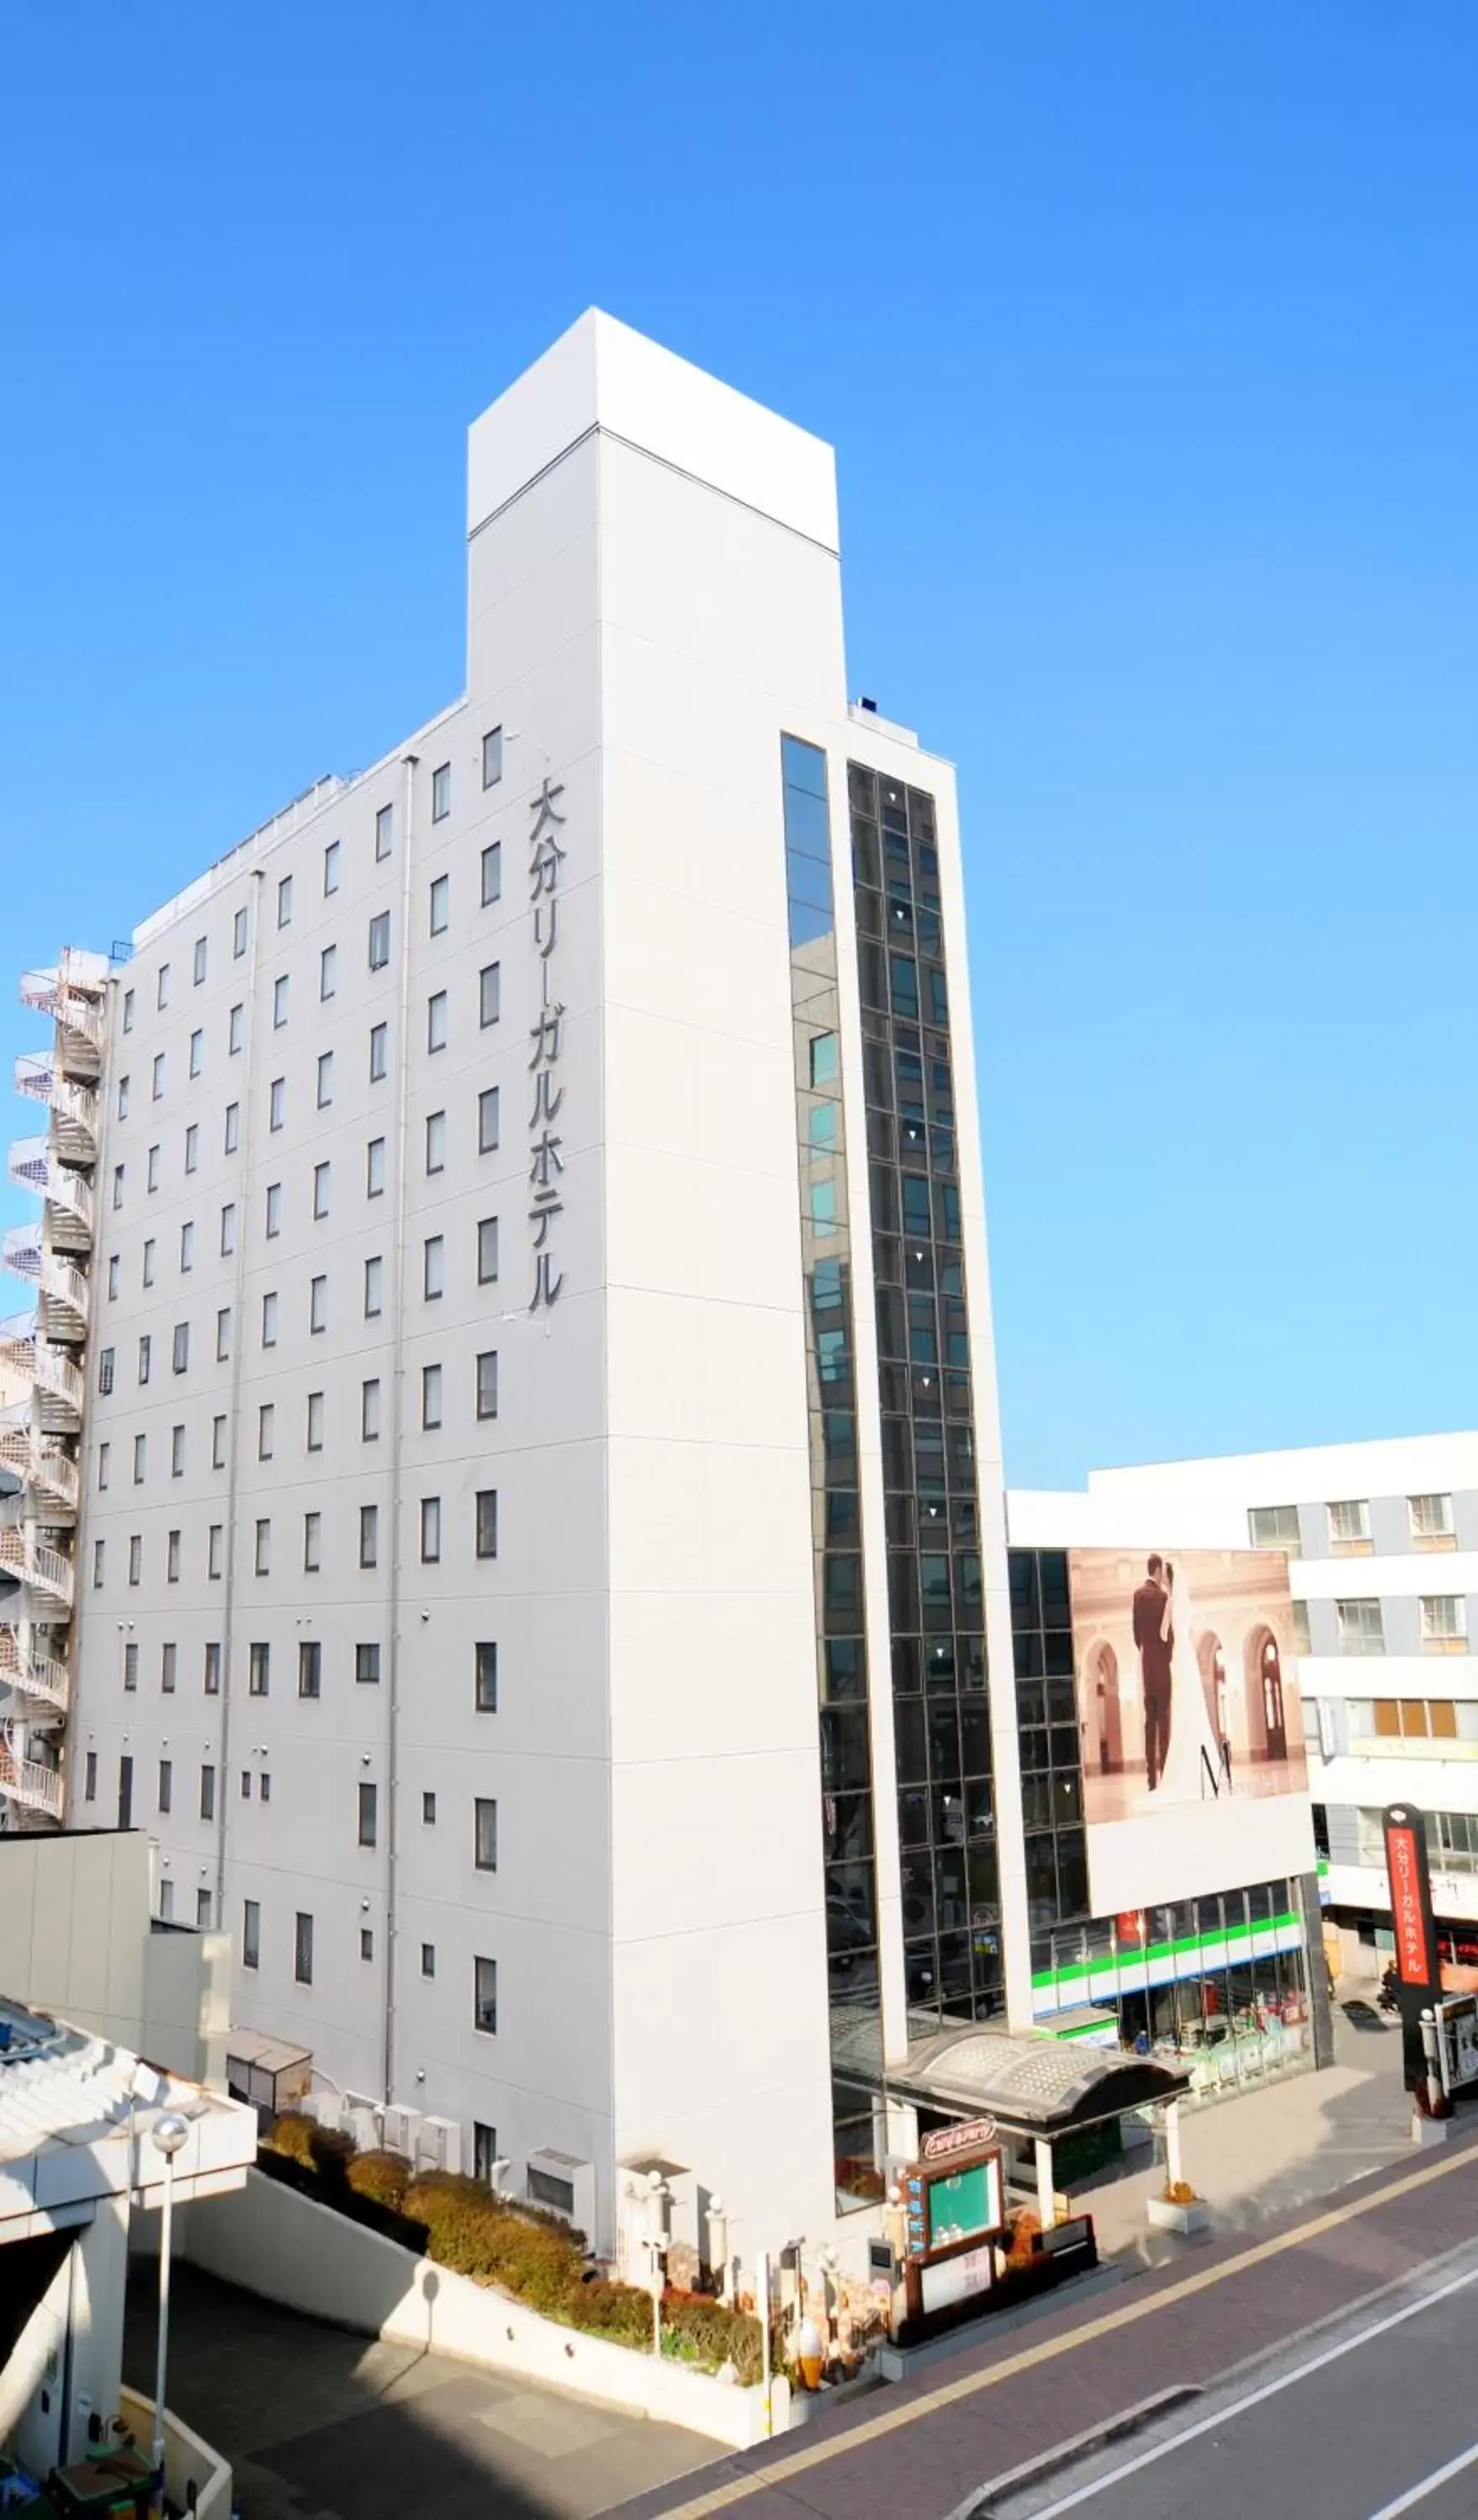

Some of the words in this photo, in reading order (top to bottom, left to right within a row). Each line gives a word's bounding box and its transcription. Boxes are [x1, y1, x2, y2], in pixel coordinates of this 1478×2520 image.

[529, 776, 566, 1311] 大分リーガルホテル
[1395, 1837, 1421, 1973] 大分リーガルホテル
